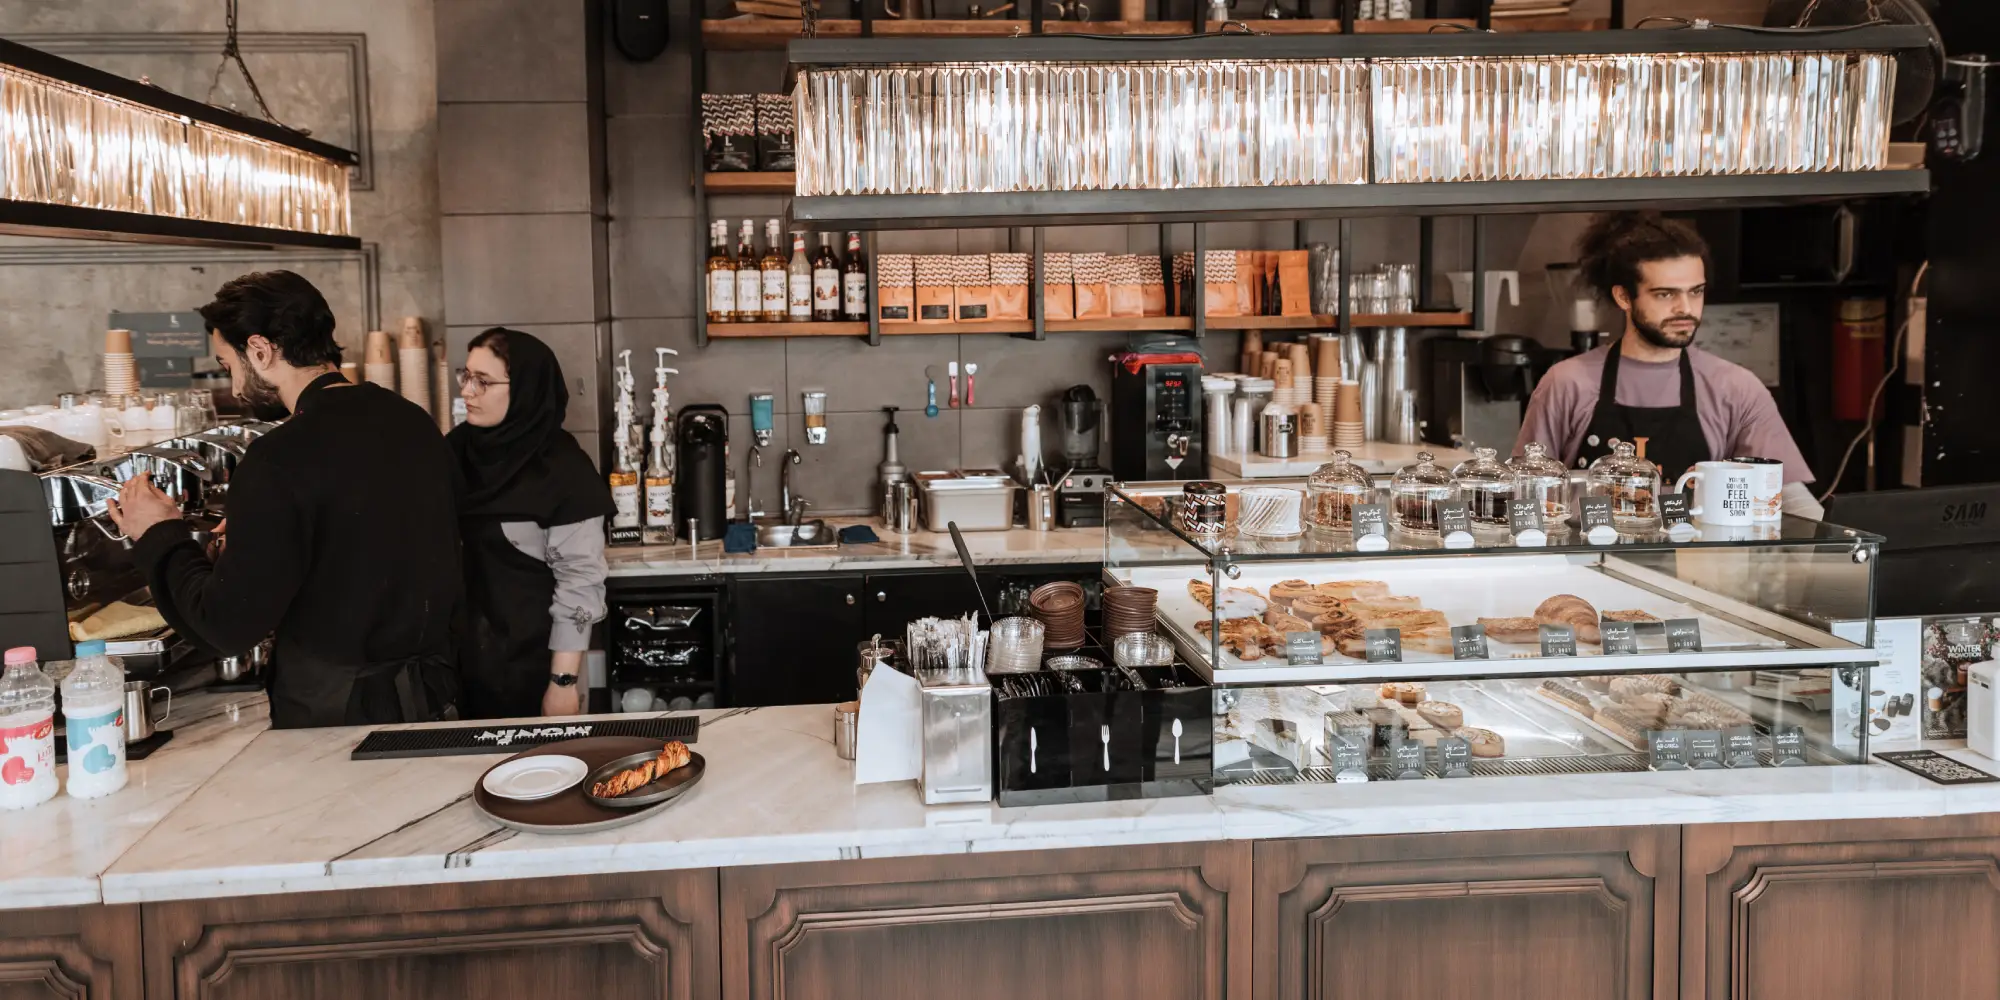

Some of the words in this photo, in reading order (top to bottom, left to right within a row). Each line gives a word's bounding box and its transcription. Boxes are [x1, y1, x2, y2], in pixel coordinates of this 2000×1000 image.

[1728, 490, 1748, 500] FEEL
[1723, 500, 1750, 509] BETTER
[612, 531, 640, 539] MONIN
